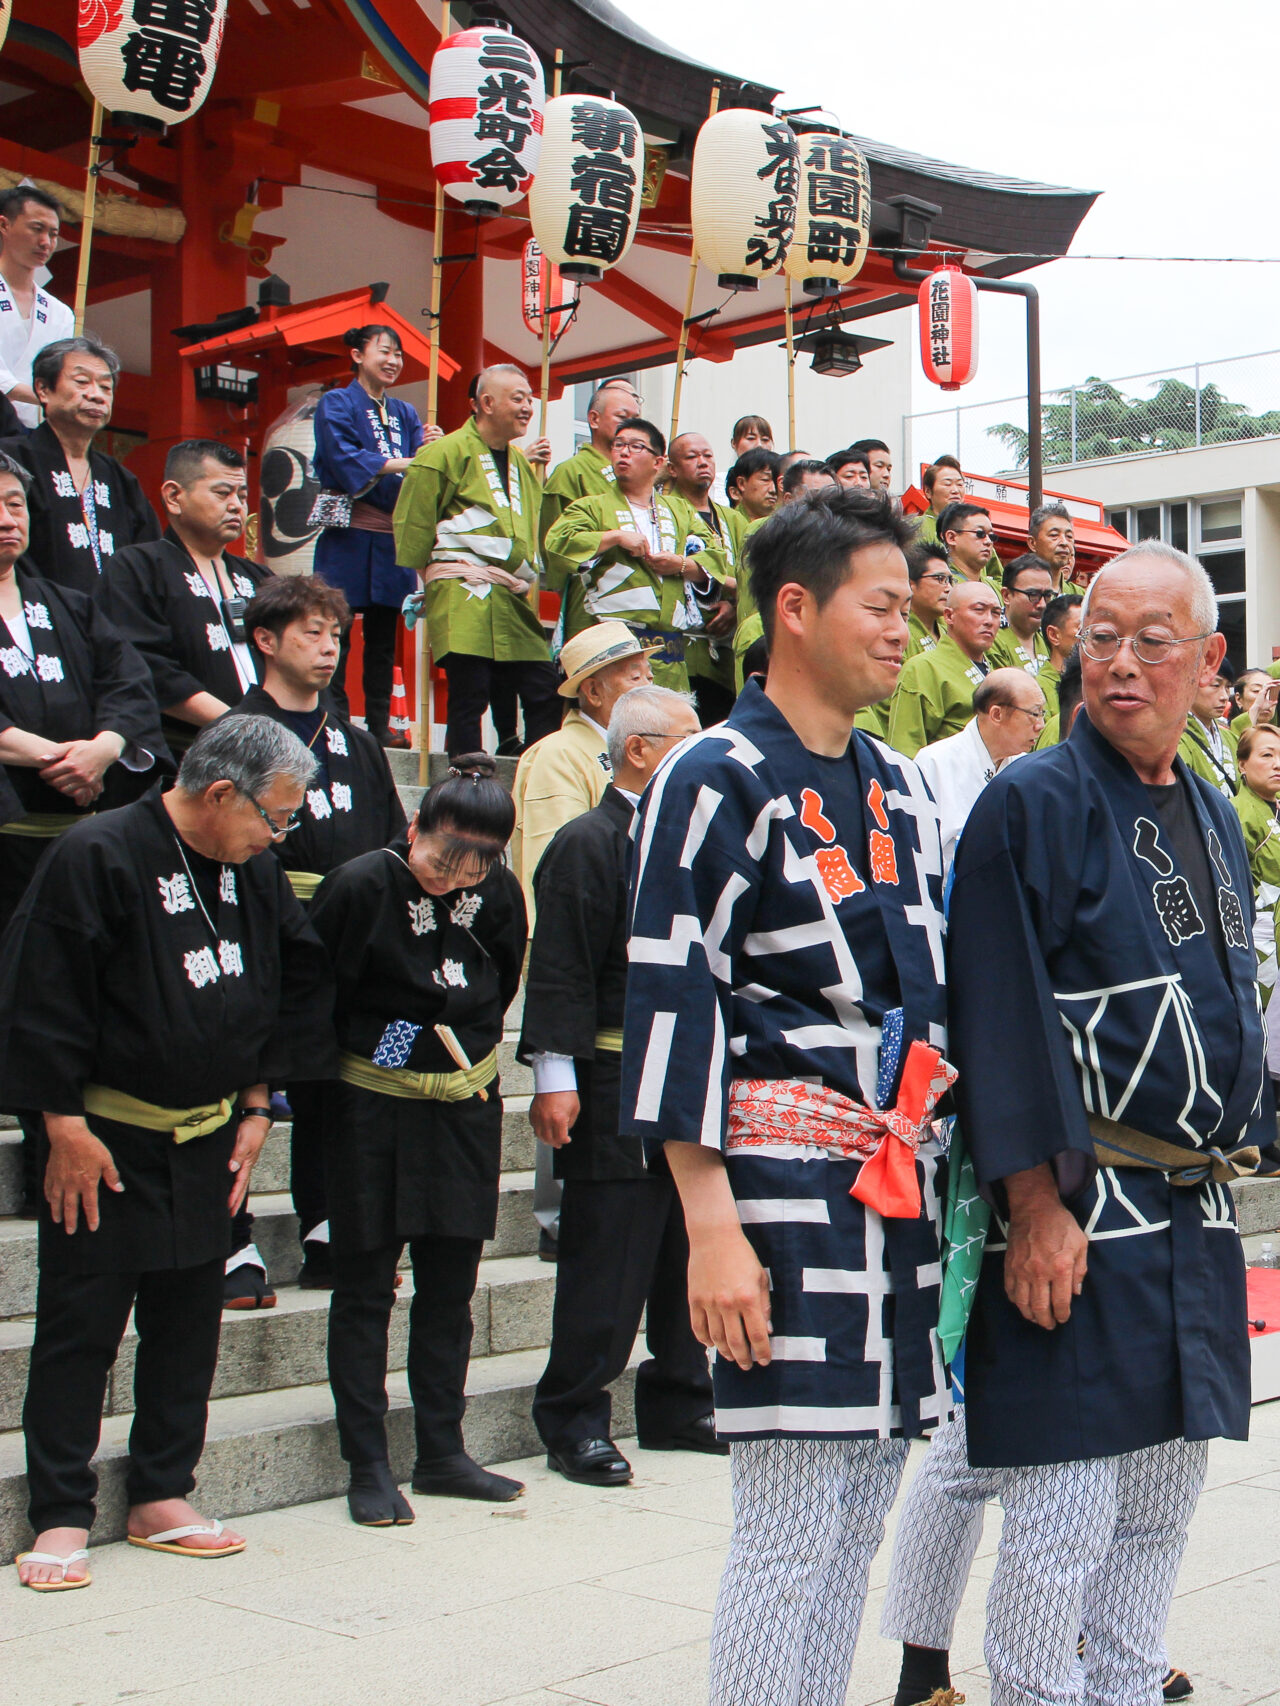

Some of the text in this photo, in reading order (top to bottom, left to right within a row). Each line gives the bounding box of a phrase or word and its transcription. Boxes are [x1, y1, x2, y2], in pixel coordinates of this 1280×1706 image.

[467, 35, 536, 193] 三光町会
[804, 136, 861, 266] 花園町
[930, 280, 951, 367] 花園神社
[51, 470, 92, 549] 渡御
[24, 600, 64, 683] 渡御
[156, 872, 221, 989] 渡御
[219, 864, 244, 977] 渡御
